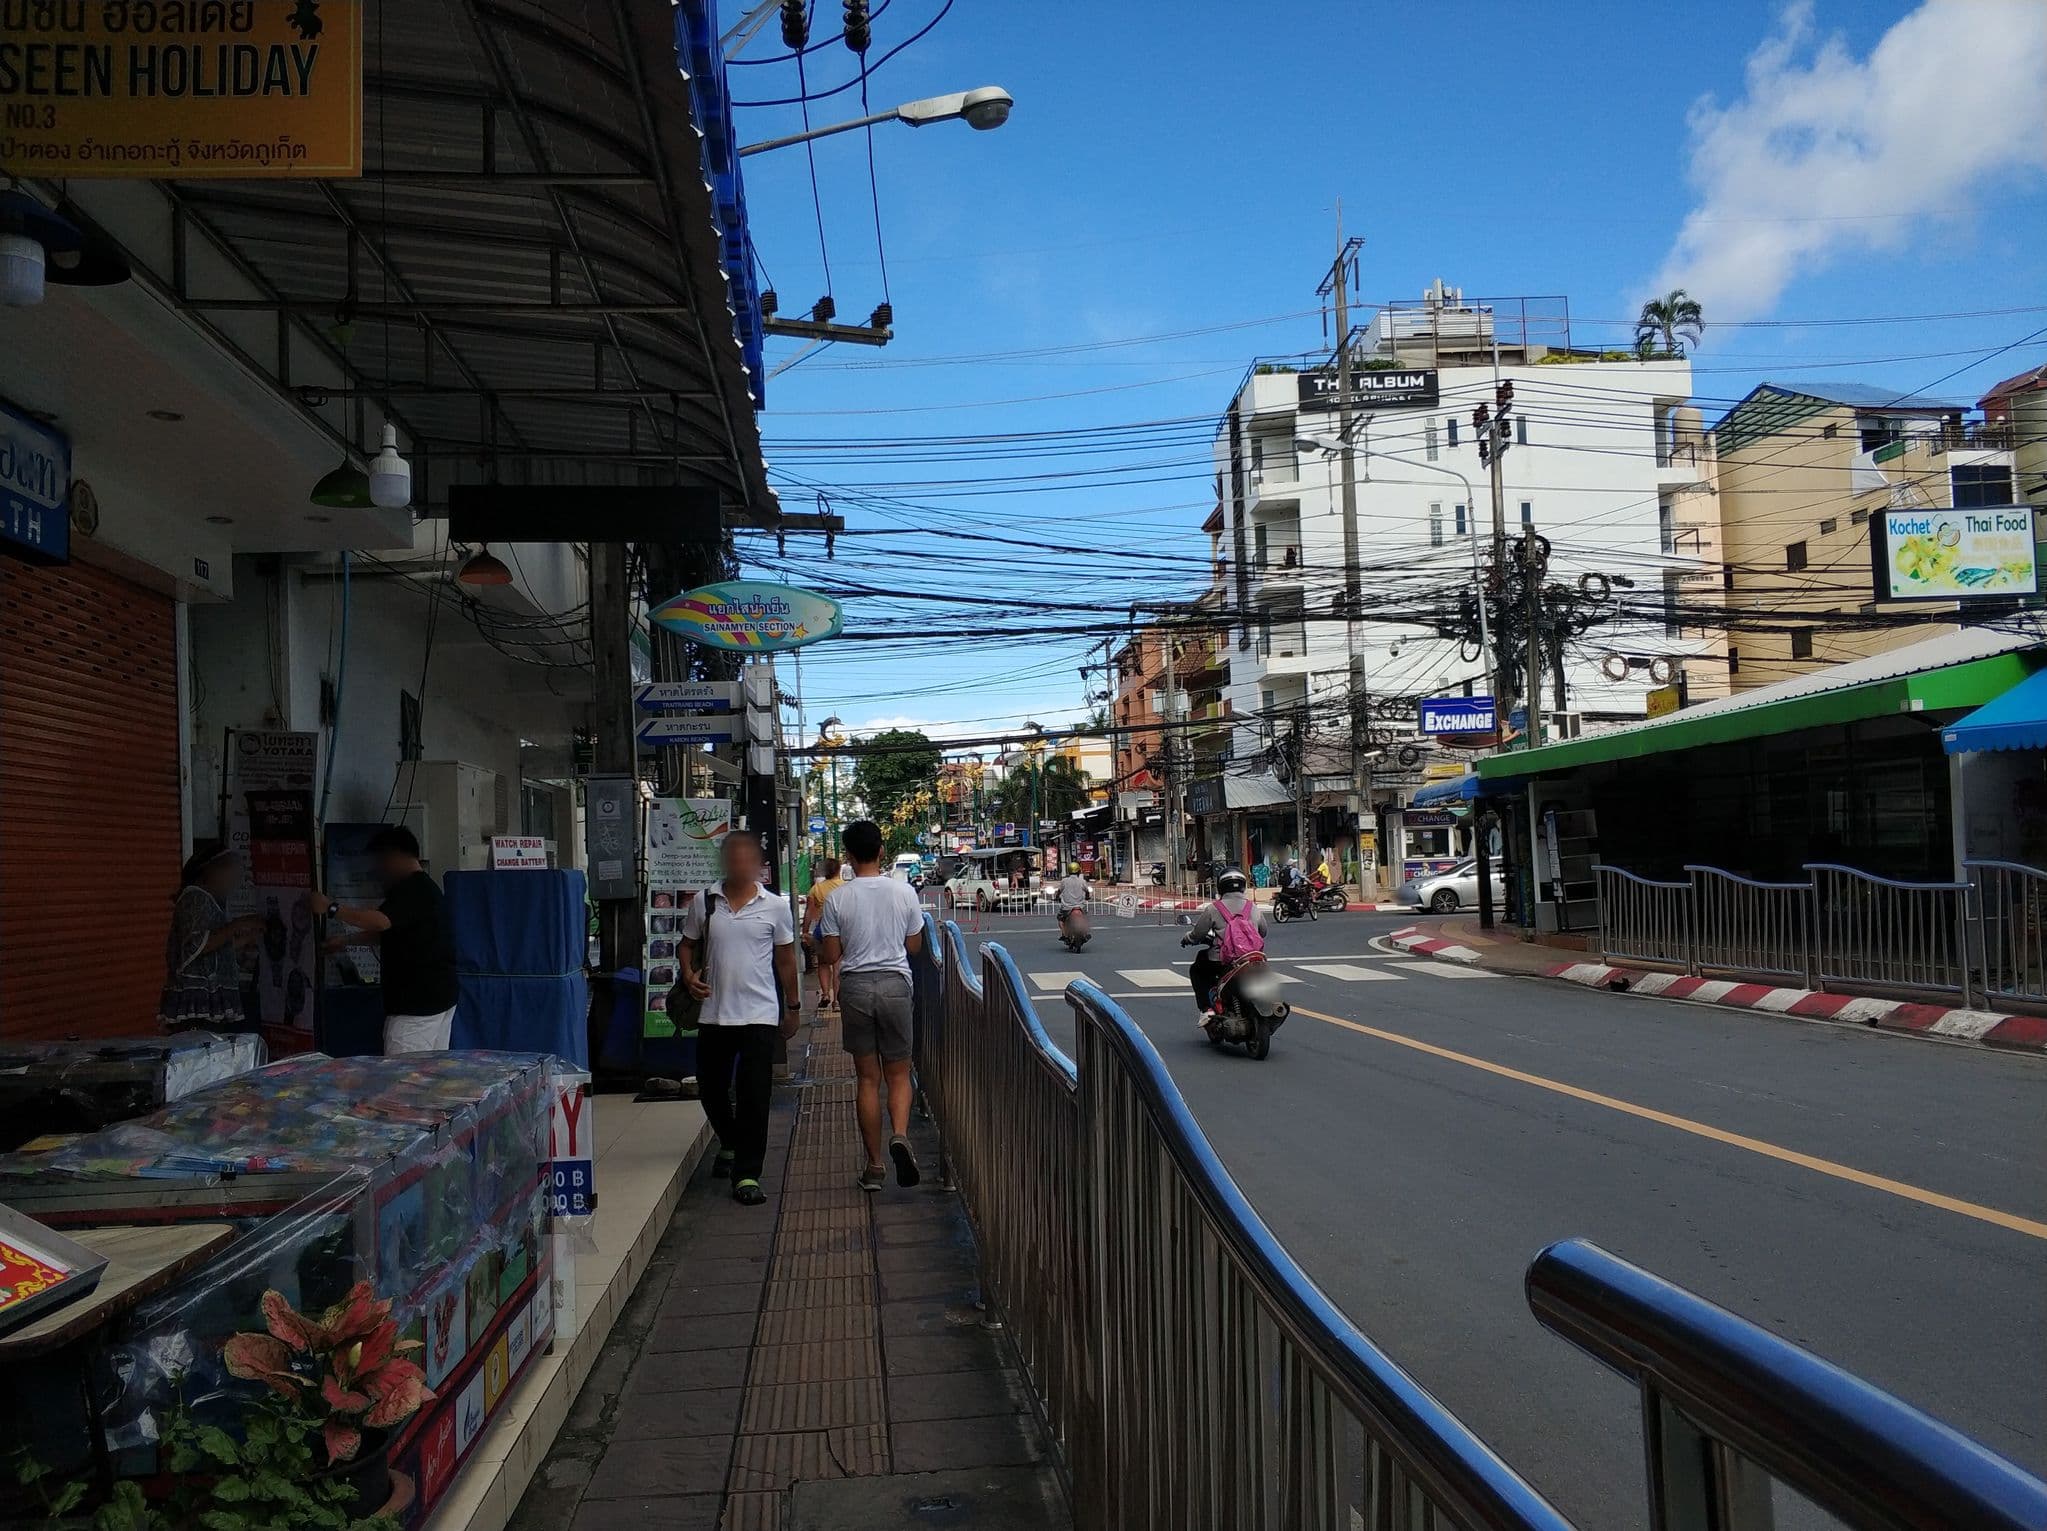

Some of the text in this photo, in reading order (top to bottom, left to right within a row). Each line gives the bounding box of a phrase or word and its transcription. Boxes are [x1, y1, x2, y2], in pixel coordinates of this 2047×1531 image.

[129, 43, 320, 97] HOLIDAY
[7, 104, 56, 129] NO.3
[187, 136, 307, 166] จังหวัดภูเก็ต
[1313, 375, 1425, 391] TH ALBUM
[1889, 514, 2027, 535] Kochet Thai Food
[704, 622, 795, 632] SAINAMYEN SECTION
[1425, 711, 1493, 731] EXCHANGE
[495, 839, 542, 848] WATCH REPAIR
[496, 857, 546, 866] CHANGE BATTERY
